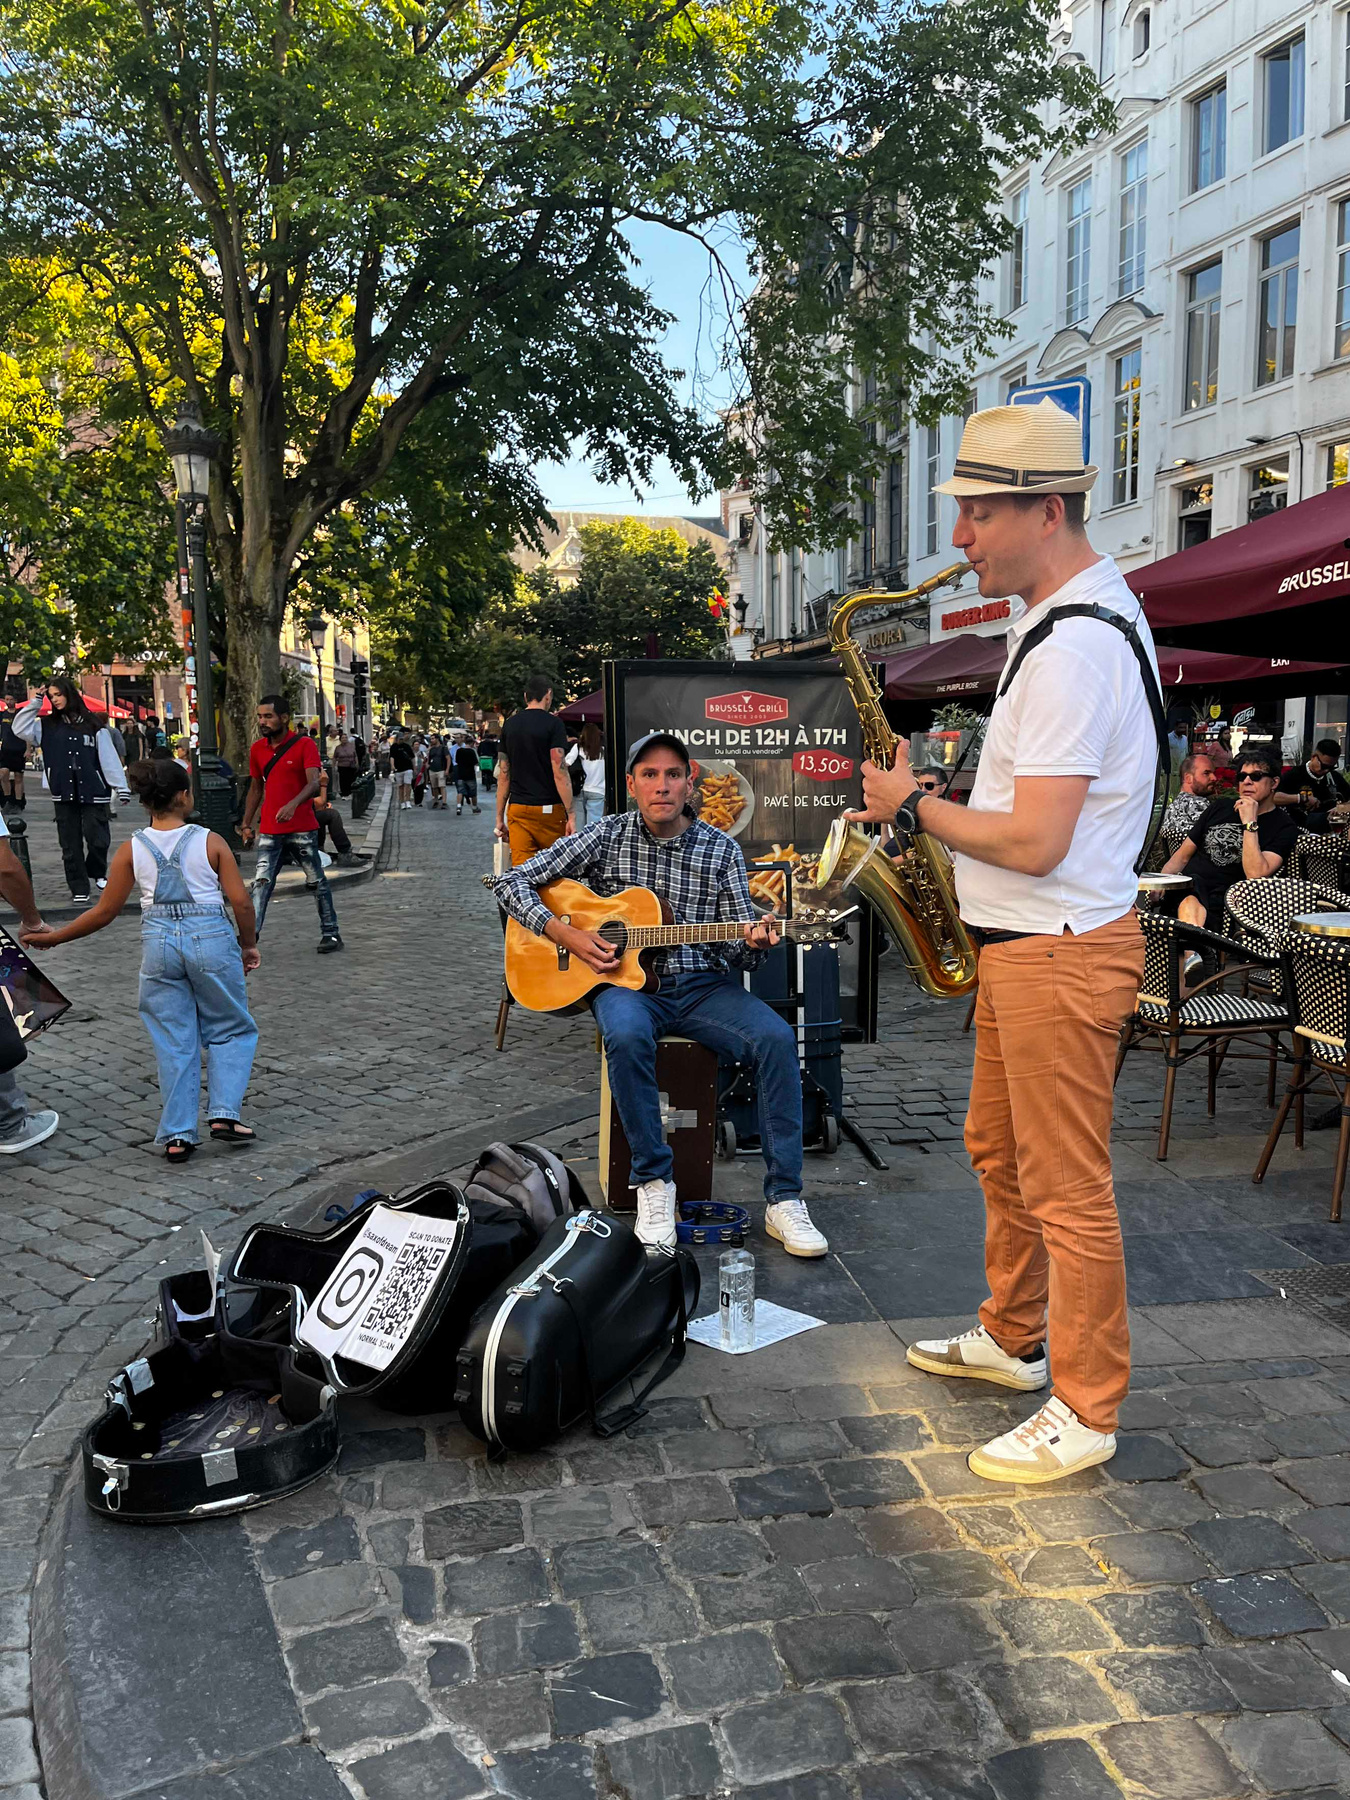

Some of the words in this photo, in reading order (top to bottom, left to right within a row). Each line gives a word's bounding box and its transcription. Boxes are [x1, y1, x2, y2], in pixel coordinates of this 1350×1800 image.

[1278, 560, 1350, 594] BRUSSEL
[941, 606, 982, 631] BURGER
[982, 599, 1011, 622] KING
[865, 628, 905, 649] AGORA
[936, 685, 946, 693] THE
[945, 682, 965, 692] PURPLE
[965, 681, 980, 689] ROSE
[709, 704, 754, 713] BRUSSELS
[758, 703, 784, 713] GRILL
[1288, 720, 1296, 729] 97
[649, 728, 720, 746] NCH
[725, 729, 751, 746] DE
[755, 728, 790, 746] 12H
[794, 723, 810, 745] À
[813, 728, 847, 745] 17H
[799, 754, 850, 775] 13,50€
[764, 794, 790, 808] PAVÉ
[794, 795, 809, 807] DE
[813, 794, 847, 807] BŒUF
[408, 1231, 424, 1240] SCAN
[424, 1234, 432, 1242] TO
[431, 1235, 453, 1245] DONATE
[357, 1333, 378, 1346] NORMAL
[378, 1339, 395, 1351] SCAN
